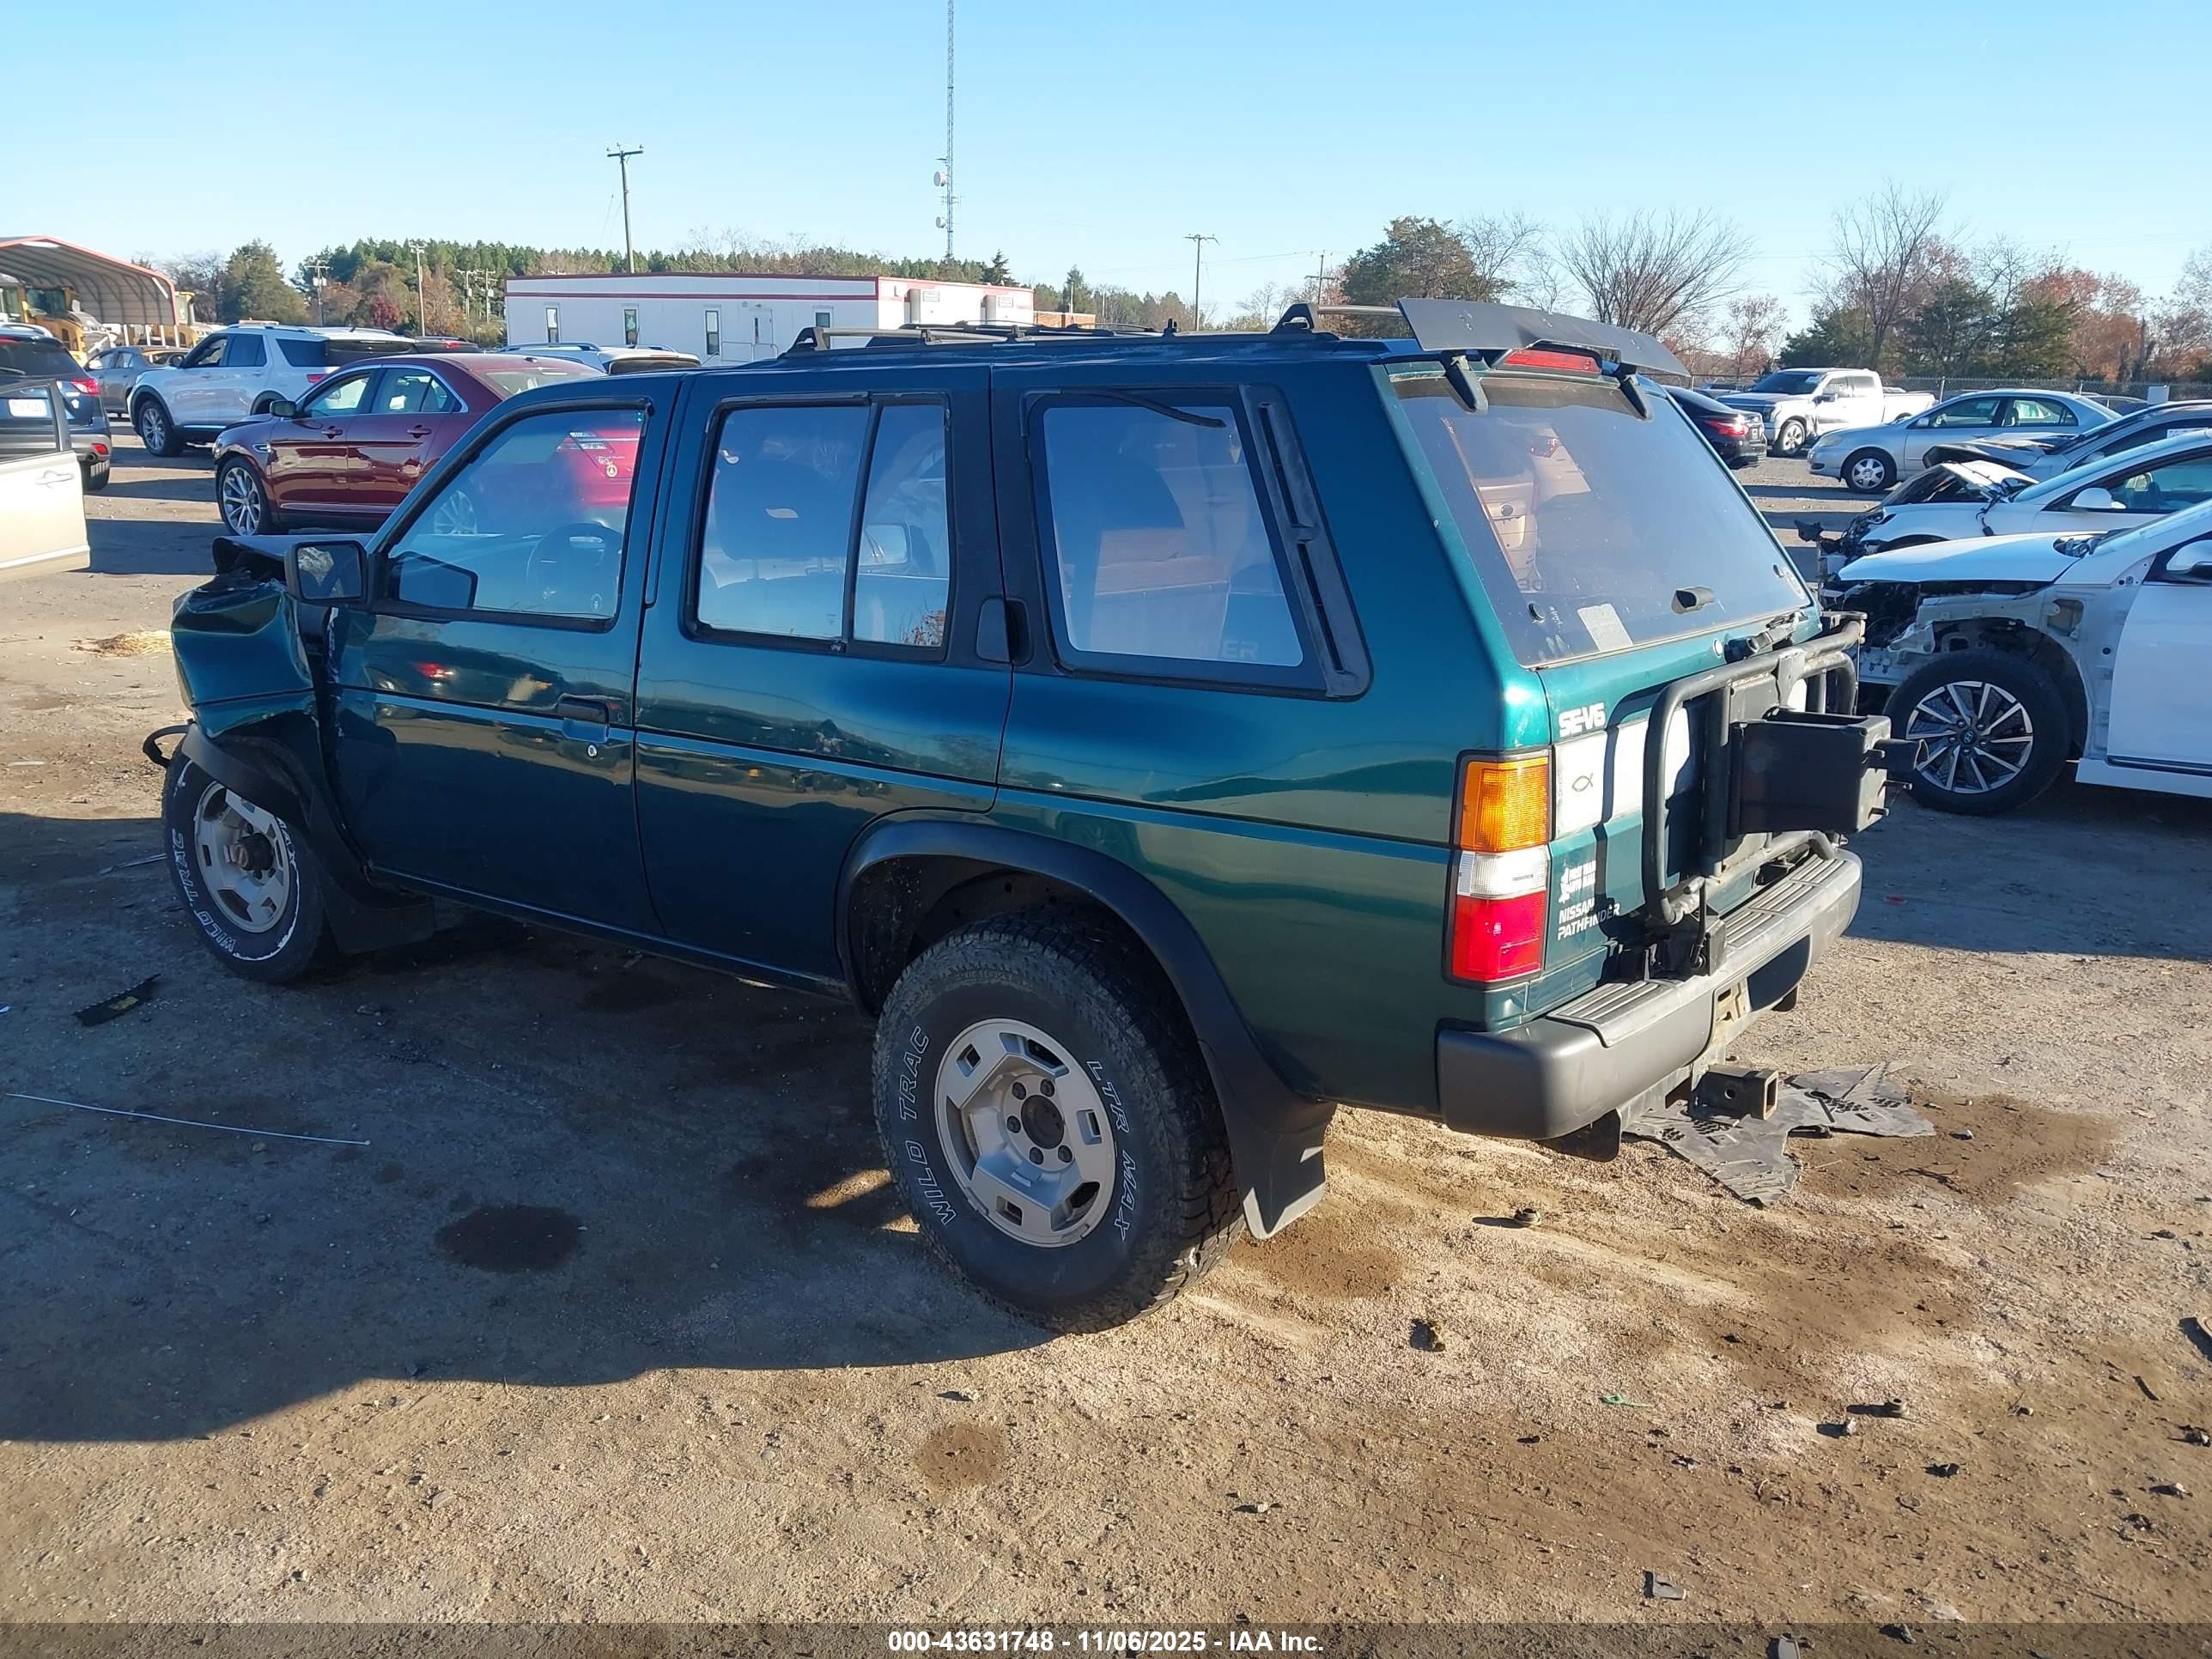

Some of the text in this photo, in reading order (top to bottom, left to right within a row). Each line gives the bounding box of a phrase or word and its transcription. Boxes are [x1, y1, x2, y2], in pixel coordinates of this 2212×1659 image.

[1557, 903, 1620, 941] PATHFINDER
[1559, 898, 1595, 925] NISSAN
[899, 1025, 958, 1226] WILD TRAC
[1085, 1060, 1139, 1242] LTR MAX
